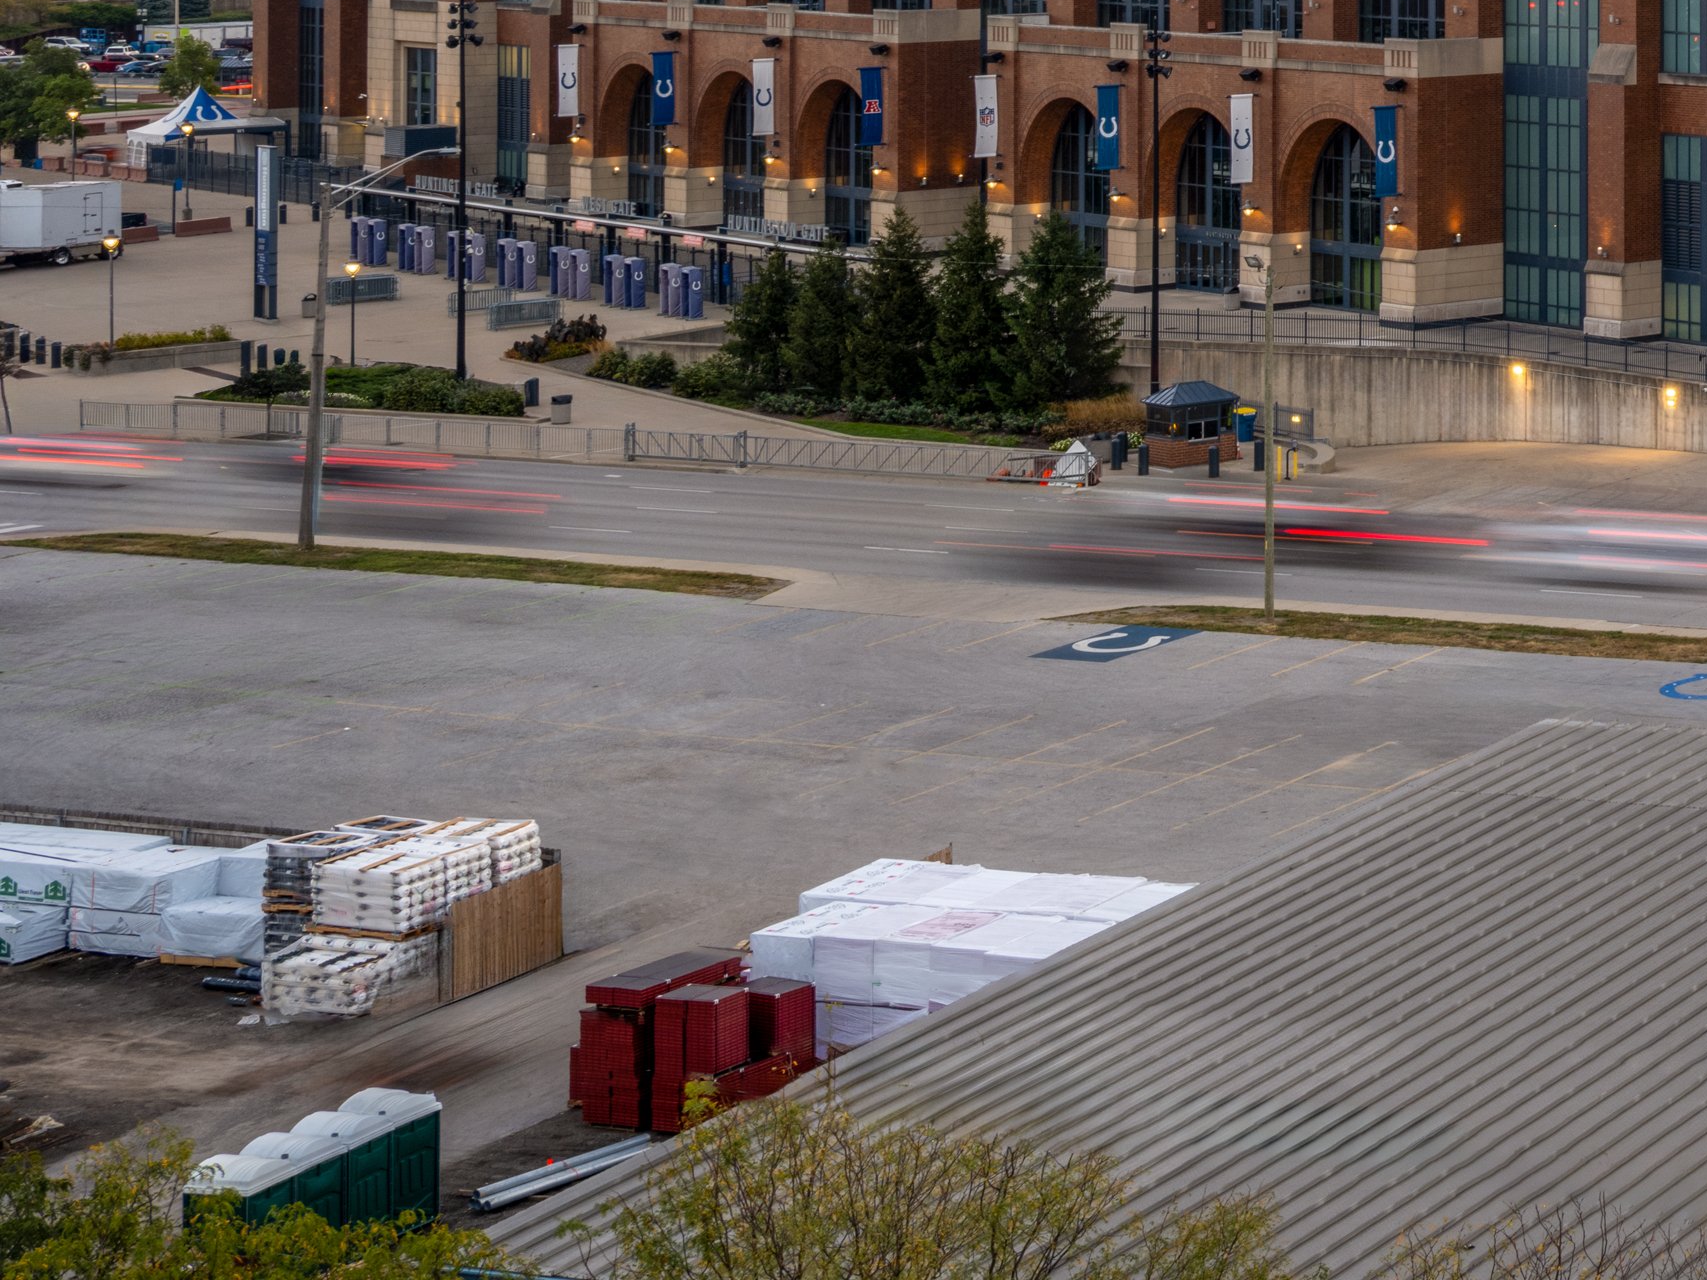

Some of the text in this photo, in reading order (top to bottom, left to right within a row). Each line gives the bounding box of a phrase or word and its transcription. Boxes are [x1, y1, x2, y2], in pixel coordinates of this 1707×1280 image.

[416, 174, 498, 198] HUNTINGTN GATE
[582, 196, 637, 217] WEST GATE
[727, 214, 830, 242] HUNTINGTON GATE
